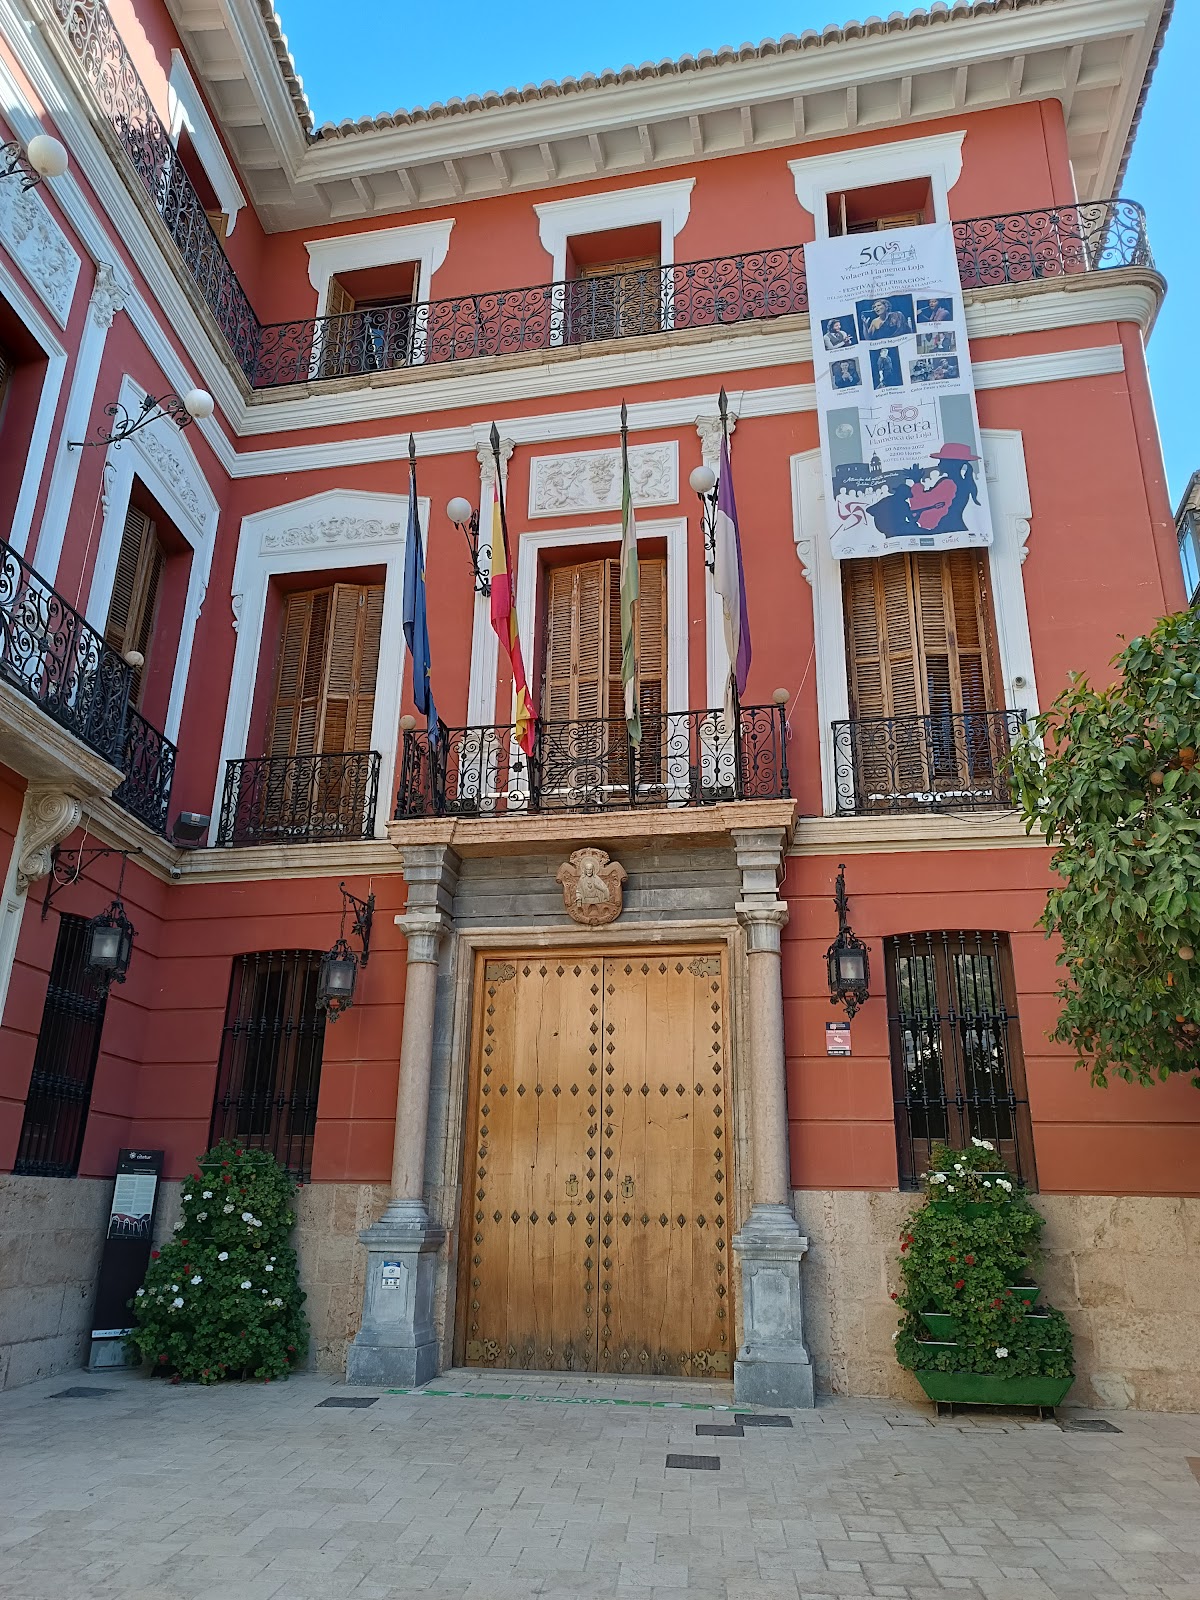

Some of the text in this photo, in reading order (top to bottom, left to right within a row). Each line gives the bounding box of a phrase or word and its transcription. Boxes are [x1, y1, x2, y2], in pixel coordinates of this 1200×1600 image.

[840, 270, 869, 281] Volaera
[870, 266, 906, 276] Flamenca
[908, 263, 925, 272] Loja
[842, 282, 876, 293] FESTIVAL
[877, 276, 926, 288] CELEBRACIÓN
[888, 403, 919, 422] 50
[865, 420, 931, 438] Volaera
[869, 434, 905, 445] Flamenca
[916, 431, 932, 440] Loja
